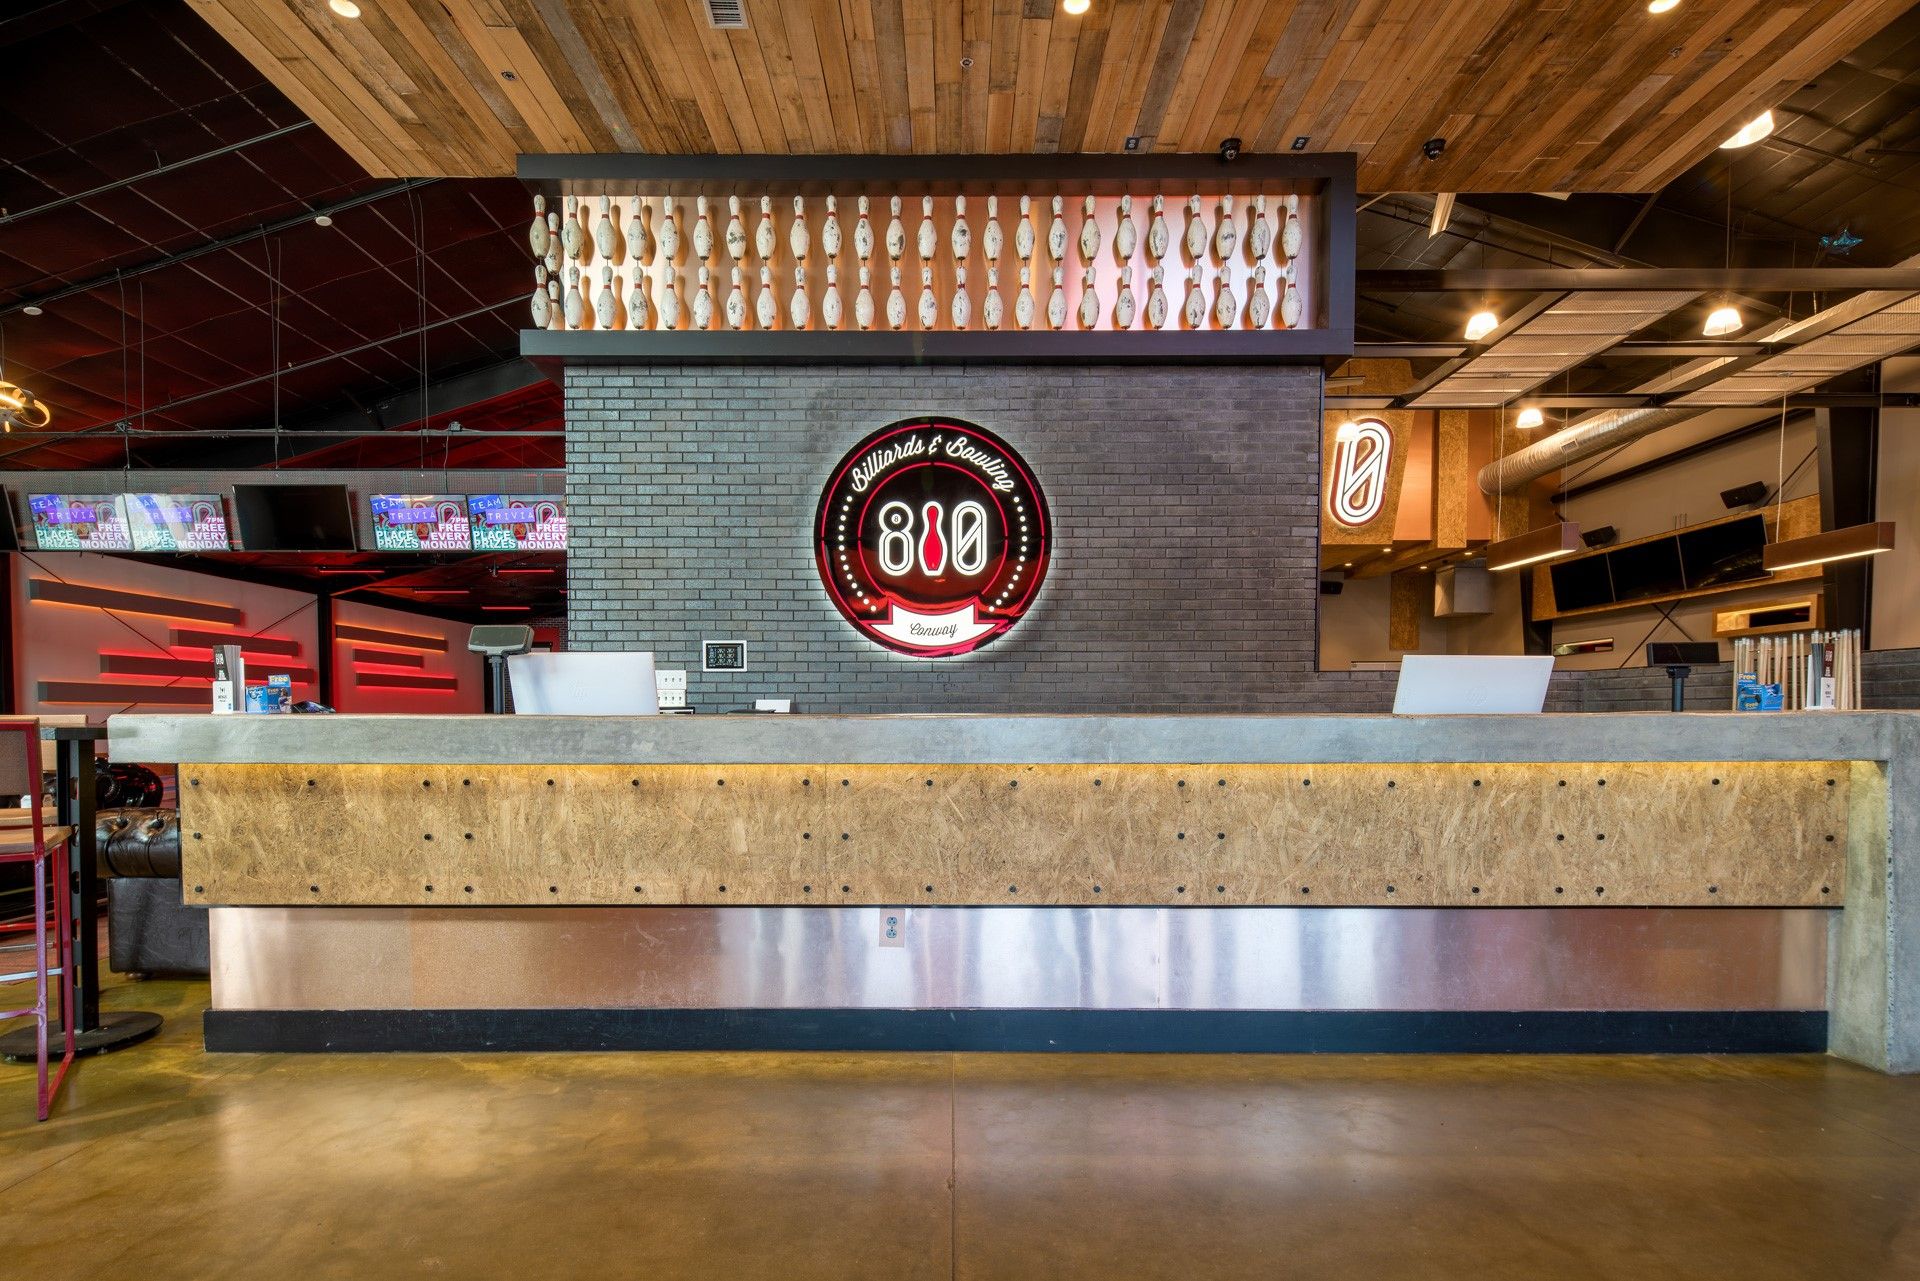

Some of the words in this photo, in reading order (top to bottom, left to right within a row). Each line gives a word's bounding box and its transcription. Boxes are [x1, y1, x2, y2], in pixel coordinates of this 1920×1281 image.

[851, 434, 925, 493] Billiards
[928, 434, 942, 455] &
[946, 436, 1015, 493] Bowling
[32, 497, 62, 510] TEAM
[470, 498, 501, 510] TEAM
[49, 511, 97, 522] TRIVIA
[390, 511, 437, 522] TRIVIA
[488, 511, 535, 522] TRIVIA
[97, 524, 129, 532] FREE
[194, 524, 226, 532] FREE
[438, 524, 470, 532] FREE
[536, 524, 567, 532] FREE
[36, 529, 73, 540] PLACE
[91, 532, 130, 541] EVERY
[187, 532, 227, 541] EVERY
[376, 530, 414, 540] PLACE
[431, 532, 470, 541] EVERY
[473, 530, 511, 540] PLACE
[528, 532, 567, 541] EVERY
[38, 538, 80, 549] PRIZES
[81, 540, 131, 549] MONDAY
[177, 540, 228, 549] MONDAY
[378, 539, 419, 549] PRIZES
[420, 540, 471, 549] MONDAY
[474, 539, 516, 549] PRIZES
[910, 622, 958, 638] Conway
